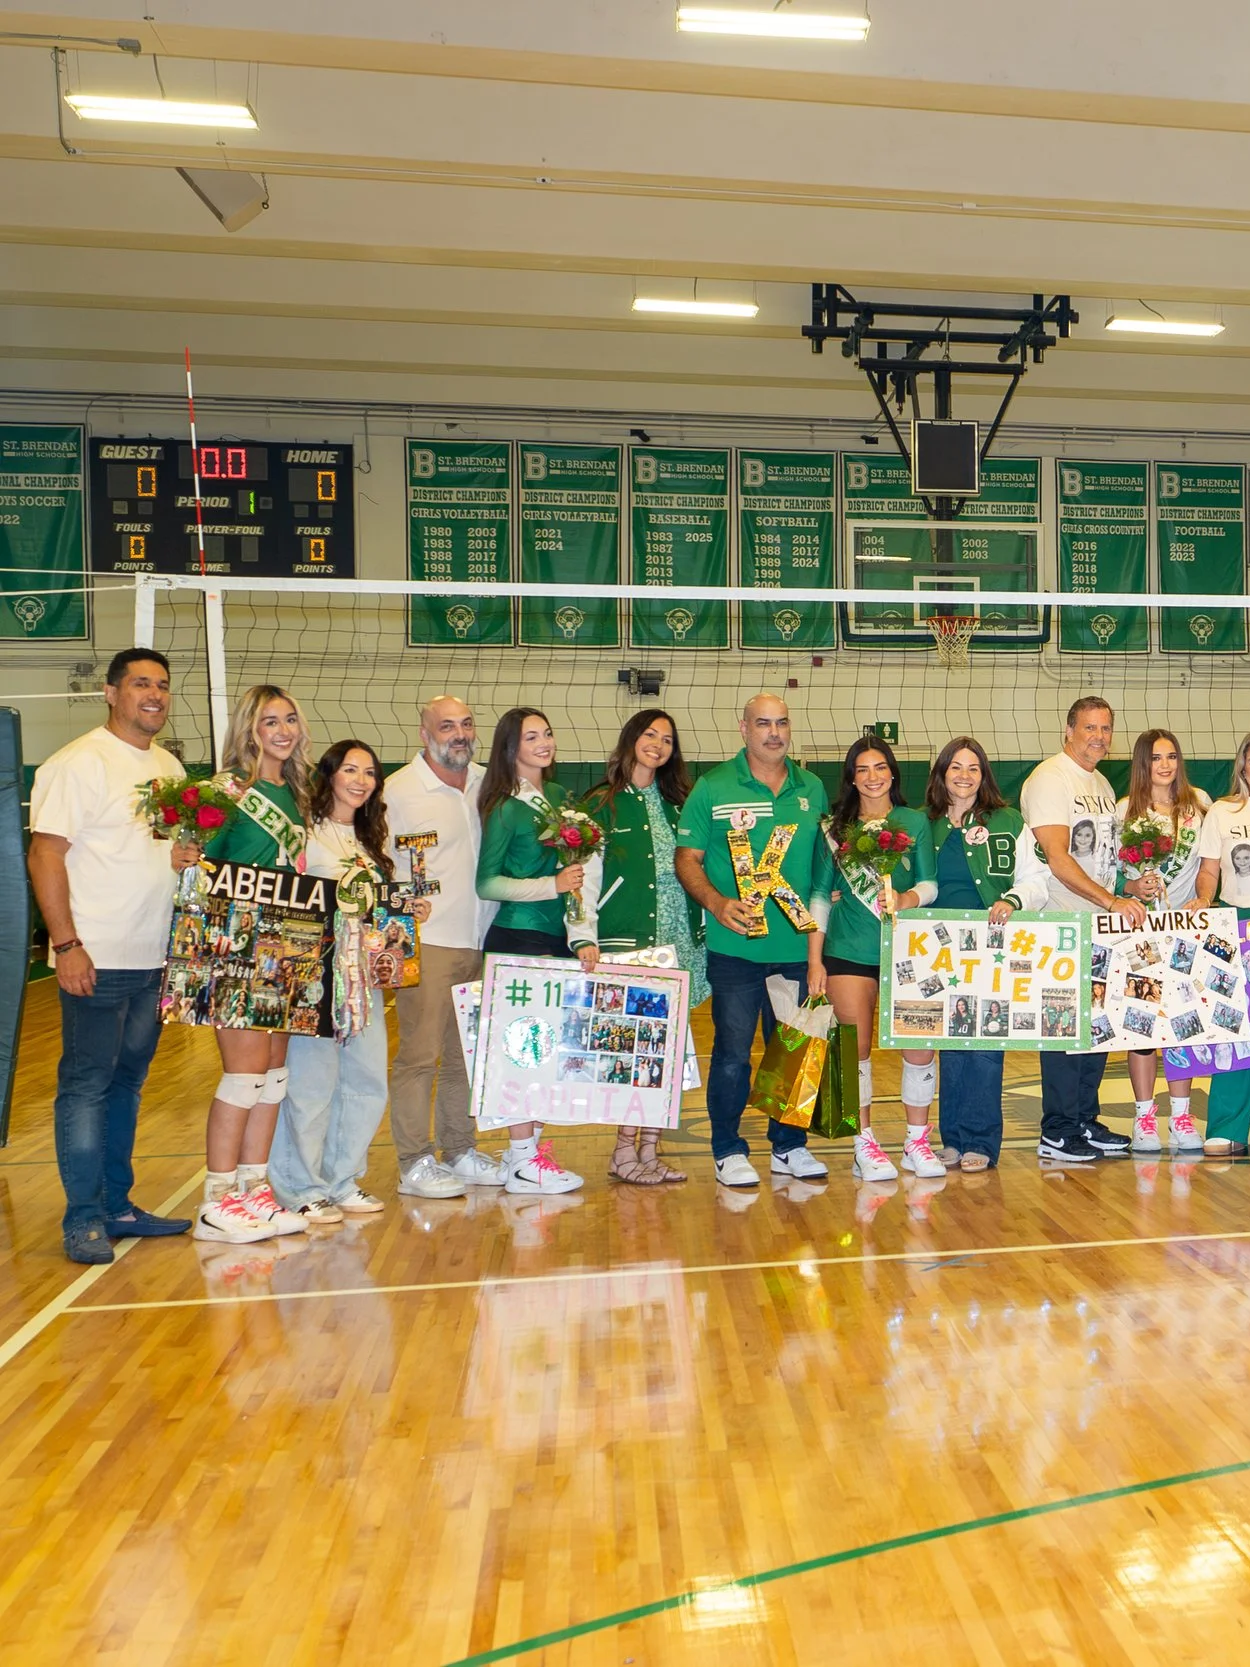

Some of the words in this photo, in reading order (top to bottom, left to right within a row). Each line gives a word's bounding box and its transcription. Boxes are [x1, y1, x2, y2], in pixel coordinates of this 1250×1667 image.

[3, 441, 19, 450] ST.
[22, 441, 77, 451] BRENDAN
[101, 446, 162, 460] GUEST
[287, 450, 338, 464] HOME
[411, 449, 436, 479] B
[438, 456, 453, 466] ST.
[455, 457, 506, 468] BRENDAN
[523, 451, 547, 480] B
[549, 460, 564, 468] ST.
[566, 461, 616, 470] BRENDAN
[635, 455, 657, 484] B
[660, 463, 675, 472] ST.
[676, 464, 724, 474] BRENDAN
[743, 458, 766, 487] B
[767, 466, 782, 475] ST.
[784, 466, 831, 476] BRENDAN
[847, 462, 869, 490] B
[870, 470, 885, 479] ST.
[990, 473, 1035, 482] BRENDAN
[25, 476, 79, 489] CHAMPIONS
[137, 467, 156, 497] 0
[317, 471, 336, 501] 0
[1061, 468, 1082, 497] B
[1084, 476, 1099, 485] ST.
[1100, 476, 1143, 485] BRENDAN
[1160, 471, 1180, 498] B
[1182, 479, 1195, 487] ST.
[1197, 479, 1240, 488] BRENDAN
[412, 489, 455, 500] DISTRICT
[456, 490, 507, 501] CHAMPIONS
[524, 491, 564, 503] DISTRICT
[566, 493, 616, 505] CHAMPIONS
[20, 496, 66, 507] SOCCER
[177, 497, 230, 508] PERIOD
[249, 491, 255, 514] 1
[635, 495, 674, 506] DISTRICT
[676, 496, 725, 508] CHAMPIONS
[743, 498, 782, 509] DISTRICT
[784, 499, 832, 510] CHAMPIONS
[848, 500, 886, 511] DISTRICT
[411, 508, 442, 518] GIRLS
[442, 509, 508, 520] VOLLEYBALL
[990, 504, 1035, 515] CHAMPIONS
[1063, 506, 1098, 517] DISTRICT
[1100, 507, 1144, 518] CHAMPIONS
[1160, 509, 1195, 519] DISTRICT
[1197, 509, 1241, 520] CHAMPIONS
[523, 511, 552, 520] GIRLS
[553, 512, 618, 523] VOLLEYBALL
[649, 514, 711, 525] BASEBALL
[756, 516, 819, 527] SOFTBALL
[116, 523, 152, 533] FOULS
[185, 525, 263, 536] PLAYER-FOUL
[296, 526, 331, 536] FOULS
[423, 526, 453, 537] 1980
[467, 527, 497, 537] 2003
[535, 529, 562, 538] 2021
[1061, 524, 1083, 533] GIRLS
[1084, 524, 1108, 535] CROSS
[1109, 525, 1145, 535] COUNTRY
[1174, 526, 1226, 536] FOOTBALL
[646, 531, 673, 541] 1983
[685, 533, 713, 542] 2025
[754, 534, 781, 544] 1984
[792, 535, 820, 545] 2014
[130, 536, 145, 559] 0
[423, 538, 453, 549] 1983
[467, 540, 497, 549] 2016
[535, 541, 563, 550] 2024
[646, 543, 673, 553] 1987
[962, 538, 989, 547] 2002
[1072, 541, 1097, 550] 2016
[1169, 543, 1195, 552] 2022
[310, 539, 325, 561] 0
[754, 545, 781, 556] 1988
[792, 547, 820, 556] 2017
[962, 550, 989, 559] 2003
[423, 551, 453, 561] 1988
[467, 551, 497, 561] 2017
[646, 555, 673, 566] 2012
[1072, 553, 1097, 561] 2017
[1169, 552, 1195, 561] 2023
[114, 562, 154, 572] POINTS
[754, 557, 781, 567] 1989
[792, 558, 820, 567] 2024
[191, 563, 225, 573] GAME
[294, 564, 334, 574] POINTS
[423, 563, 452, 573] 1991
[468, 563, 497, 574] 2018
[646, 567, 673, 577] 2013
[1072, 564, 1097, 573] 2018
[754, 569, 781, 579] 1990
[1072, 575, 1097, 584] 2019
[986, 832, 1018, 877] B
[1147, 911, 1210, 933] WIRKS
[1057, 926, 1077, 952] B
[498, 1080, 646, 1125] SOPHIA
